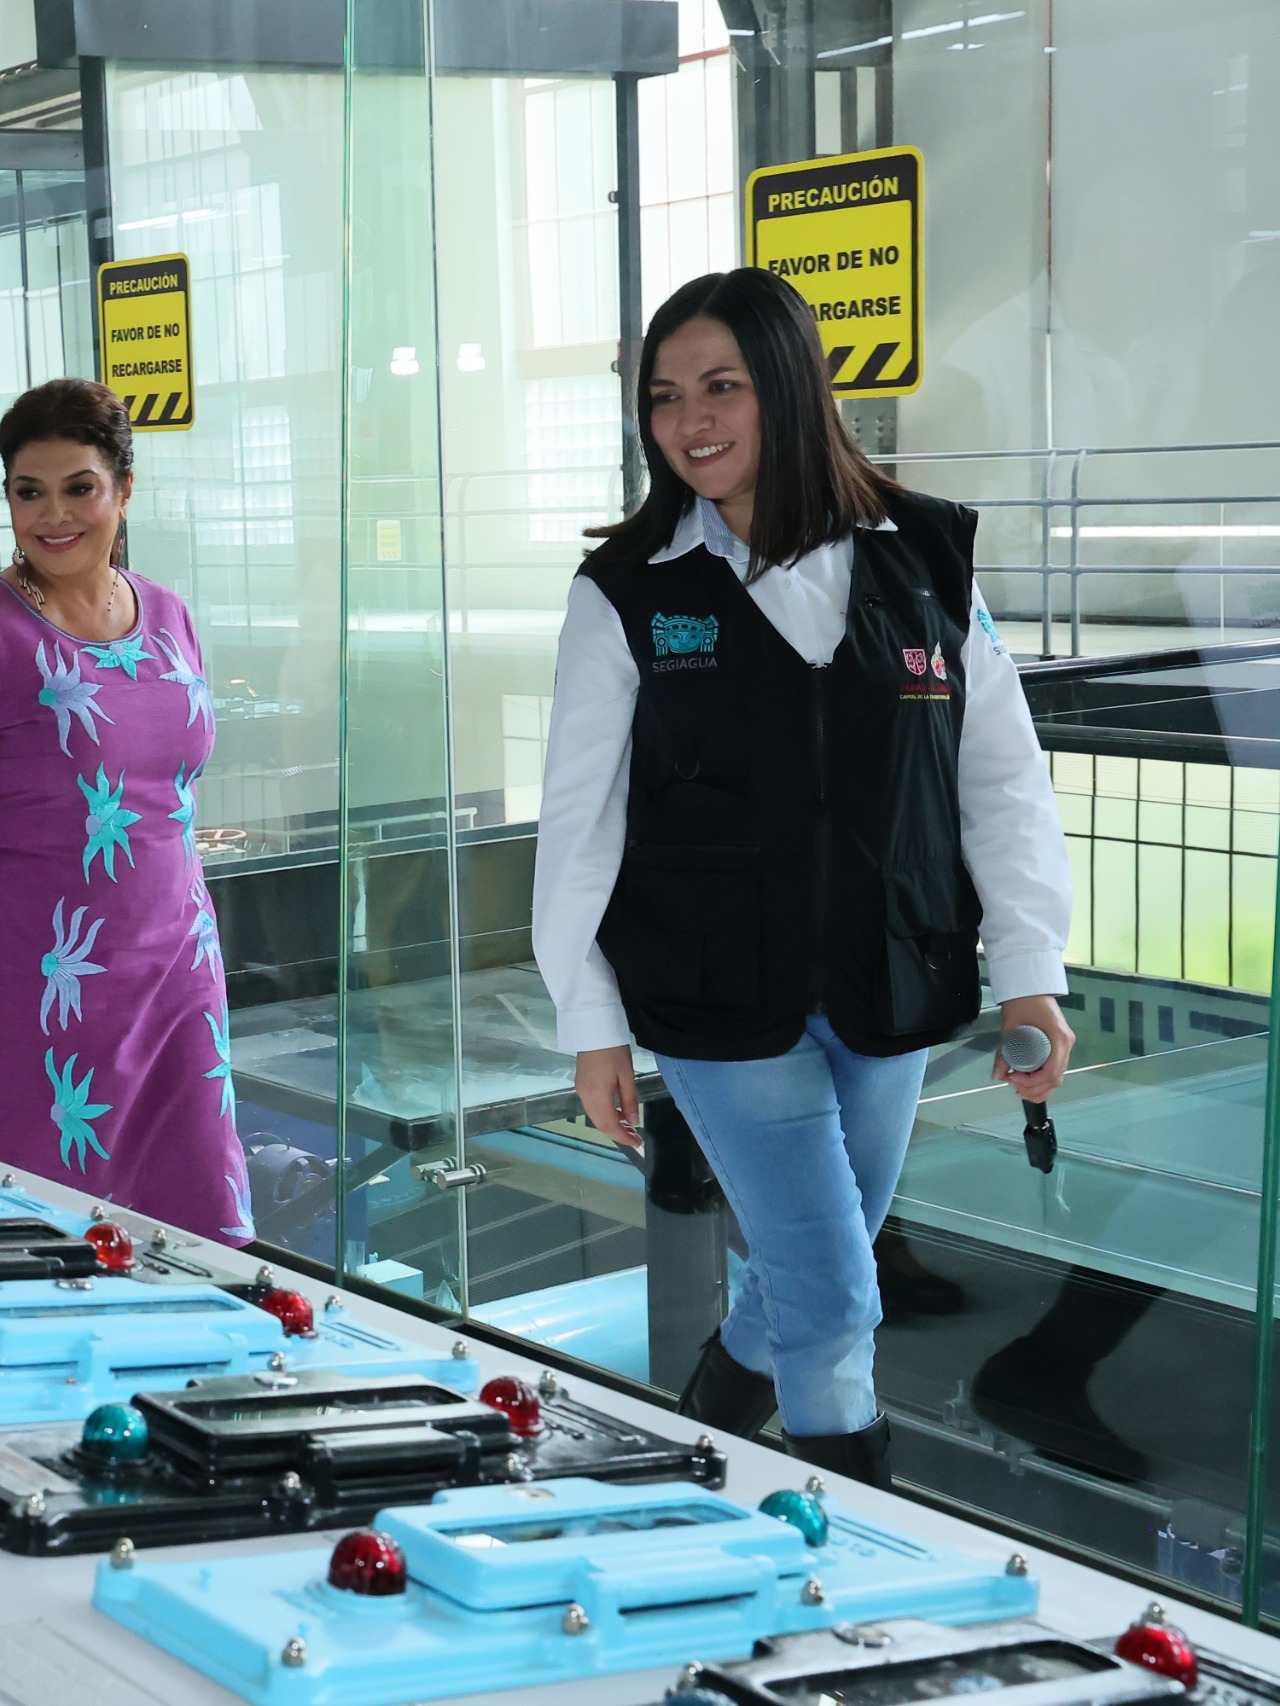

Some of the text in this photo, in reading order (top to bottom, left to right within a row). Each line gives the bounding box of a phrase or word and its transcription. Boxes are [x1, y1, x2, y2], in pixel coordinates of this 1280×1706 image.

[768, 175, 899, 212] PRECAUCIÓN
[768, 245, 899, 277] FAVOR DE NO
[109, 273, 178, 295] PRECAUCIÓN
[809, 296, 901, 322] ARGARSE
[111, 323, 180, 343] FAVOR DE NO
[112, 359, 182, 377] RECARGARSE
[652, 657, 718, 673] SEGIAGUA
